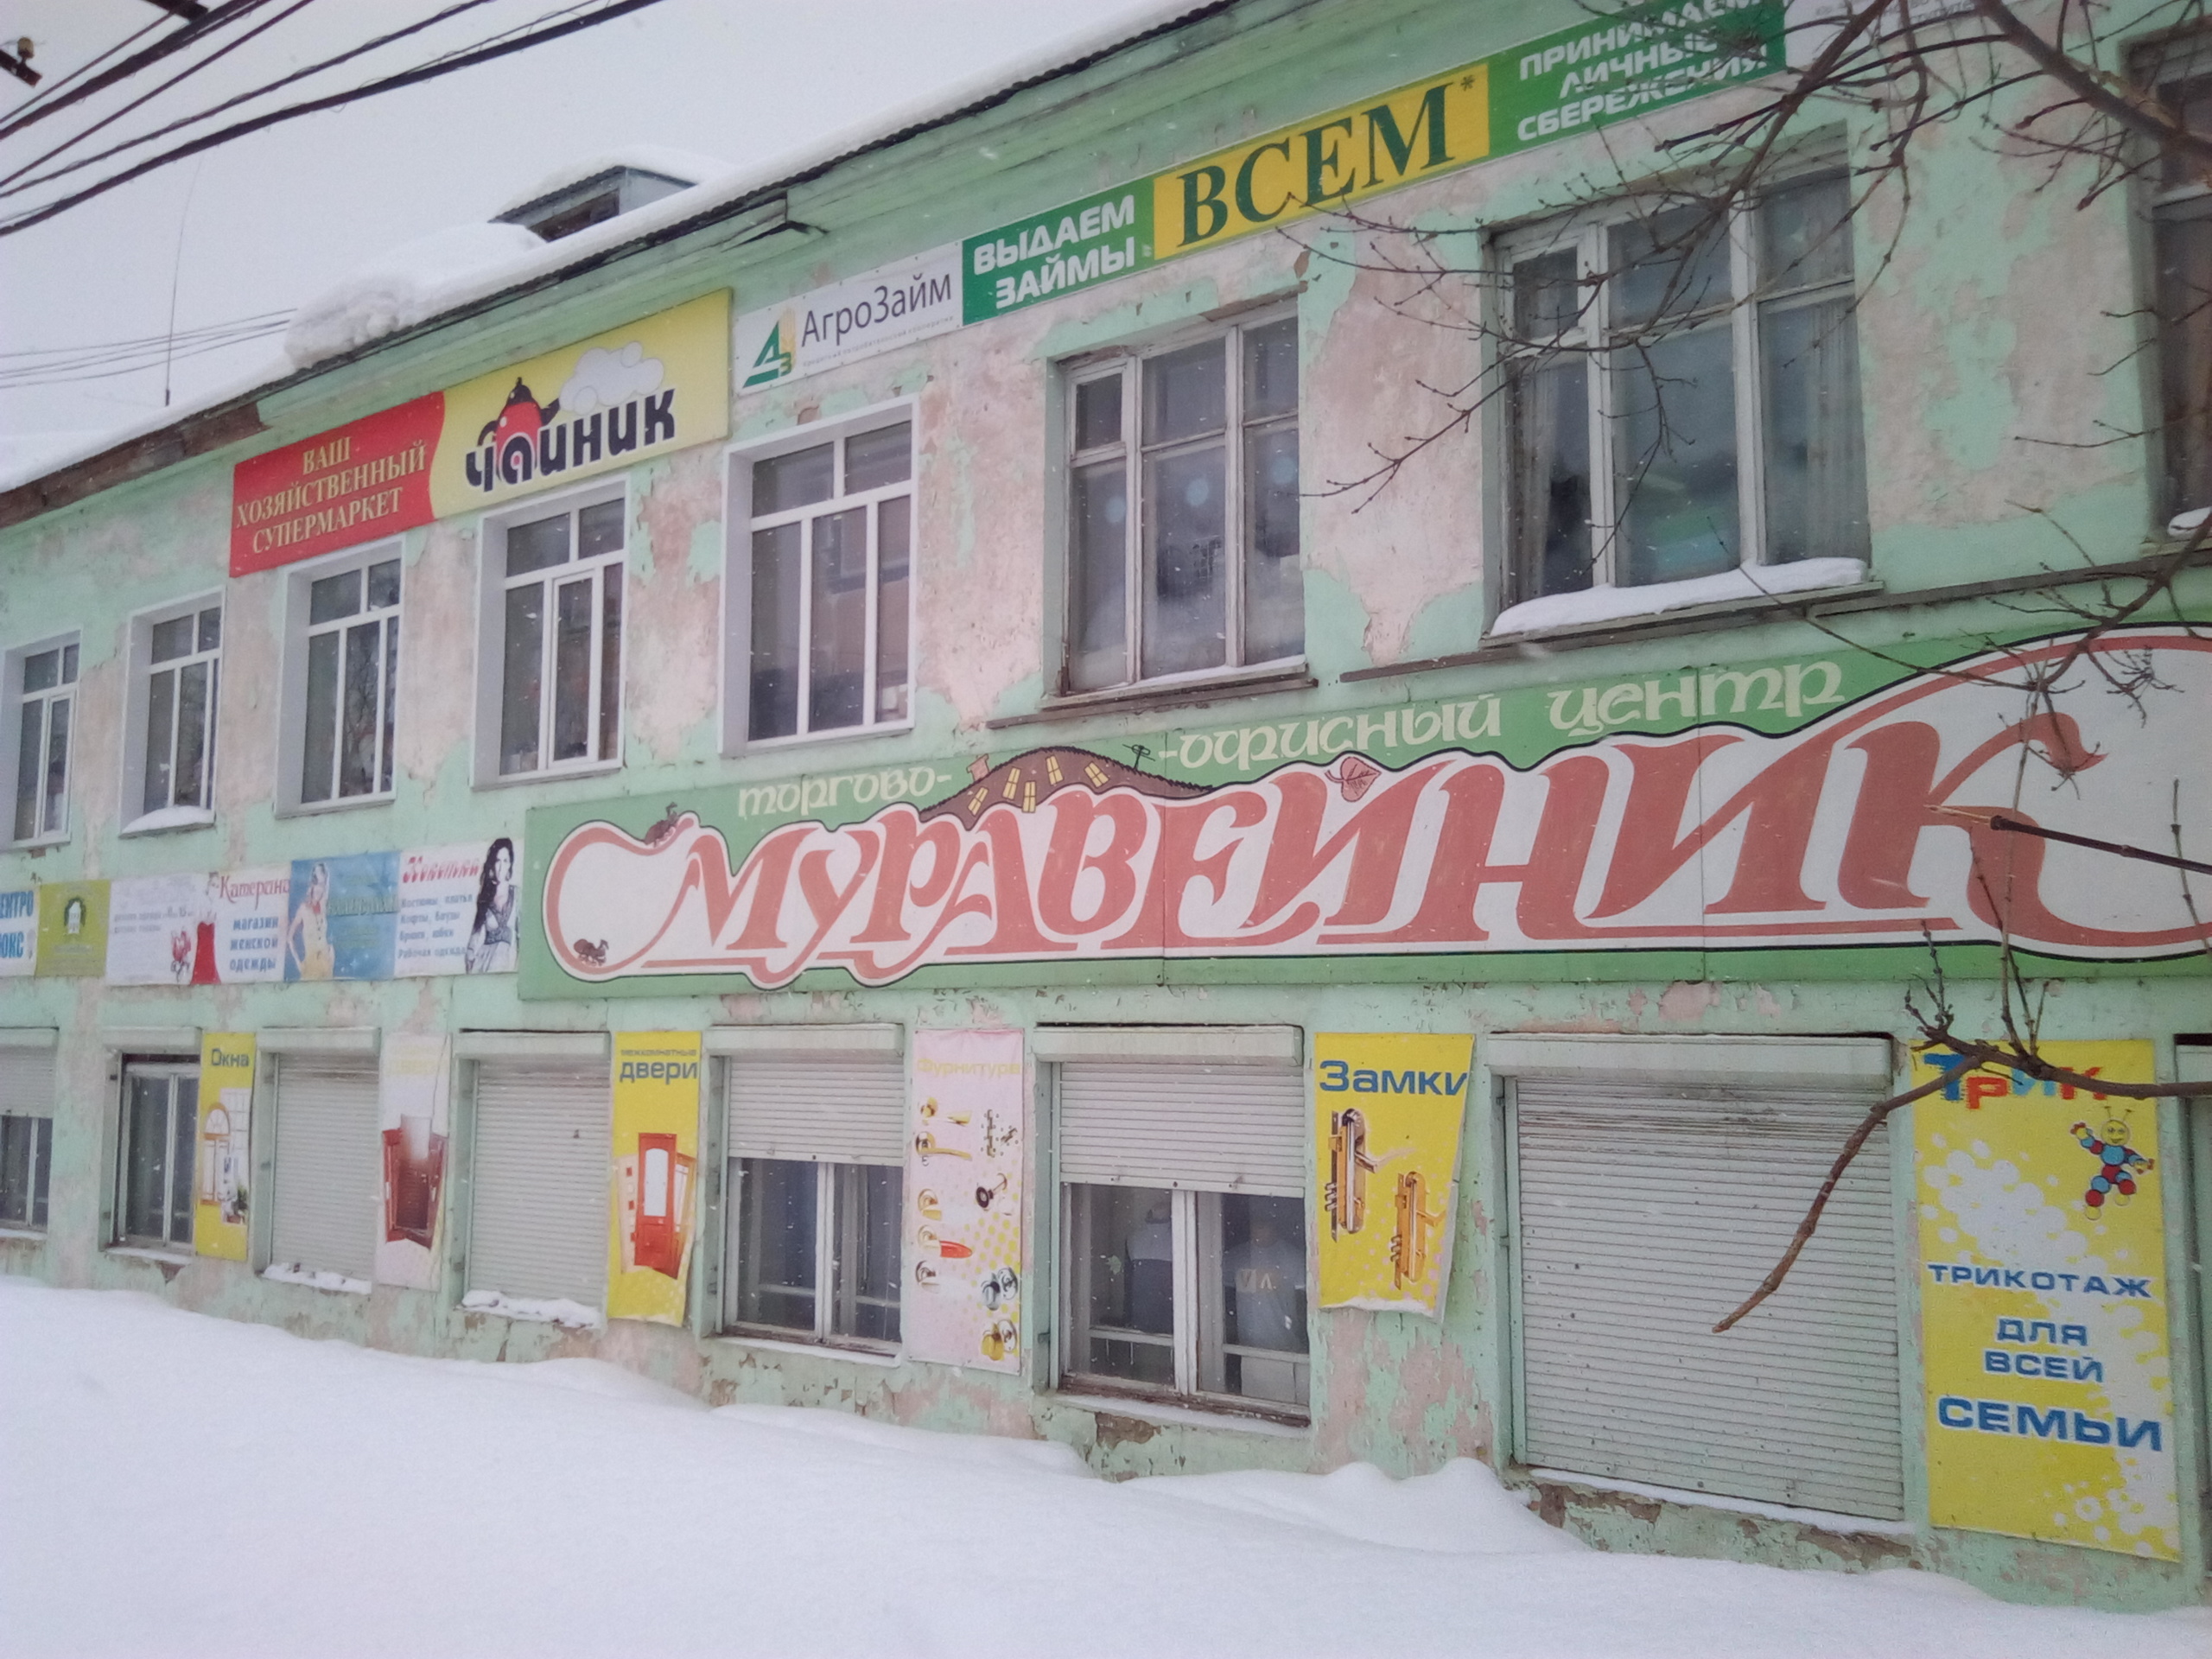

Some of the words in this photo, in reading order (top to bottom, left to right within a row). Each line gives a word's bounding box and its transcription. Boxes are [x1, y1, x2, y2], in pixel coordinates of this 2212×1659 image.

[974, 194, 1135, 276] ВЫДАЕМ
[995, 237, 1135, 309] ЗАЙМЫ
[801, 272, 951, 347] АгроЗайм
[303, 436, 352, 474] ВАШ
[236, 439, 427, 528] ХОЗЯЙСТВЕННЫЙ
[252, 486, 403, 554] СУПЕРМАРКЕТ
[1548, 660, 1847, 739] центр
[232, 917, 278, 931] магазин
[230, 937, 278, 951] женской
[229, 957, 276, 972] одежды
[211, 1048, 250, 1068] Окна
[1927, 1263, 2152, 1298] ТРИКОТАЖ
[1997, 1317, 2088, 1347] ДЛЯ
[1984, 1351, 2105, 1382] ВСЕЙ
[1938, 1396, 2163, 1452] СЕМЬИ
